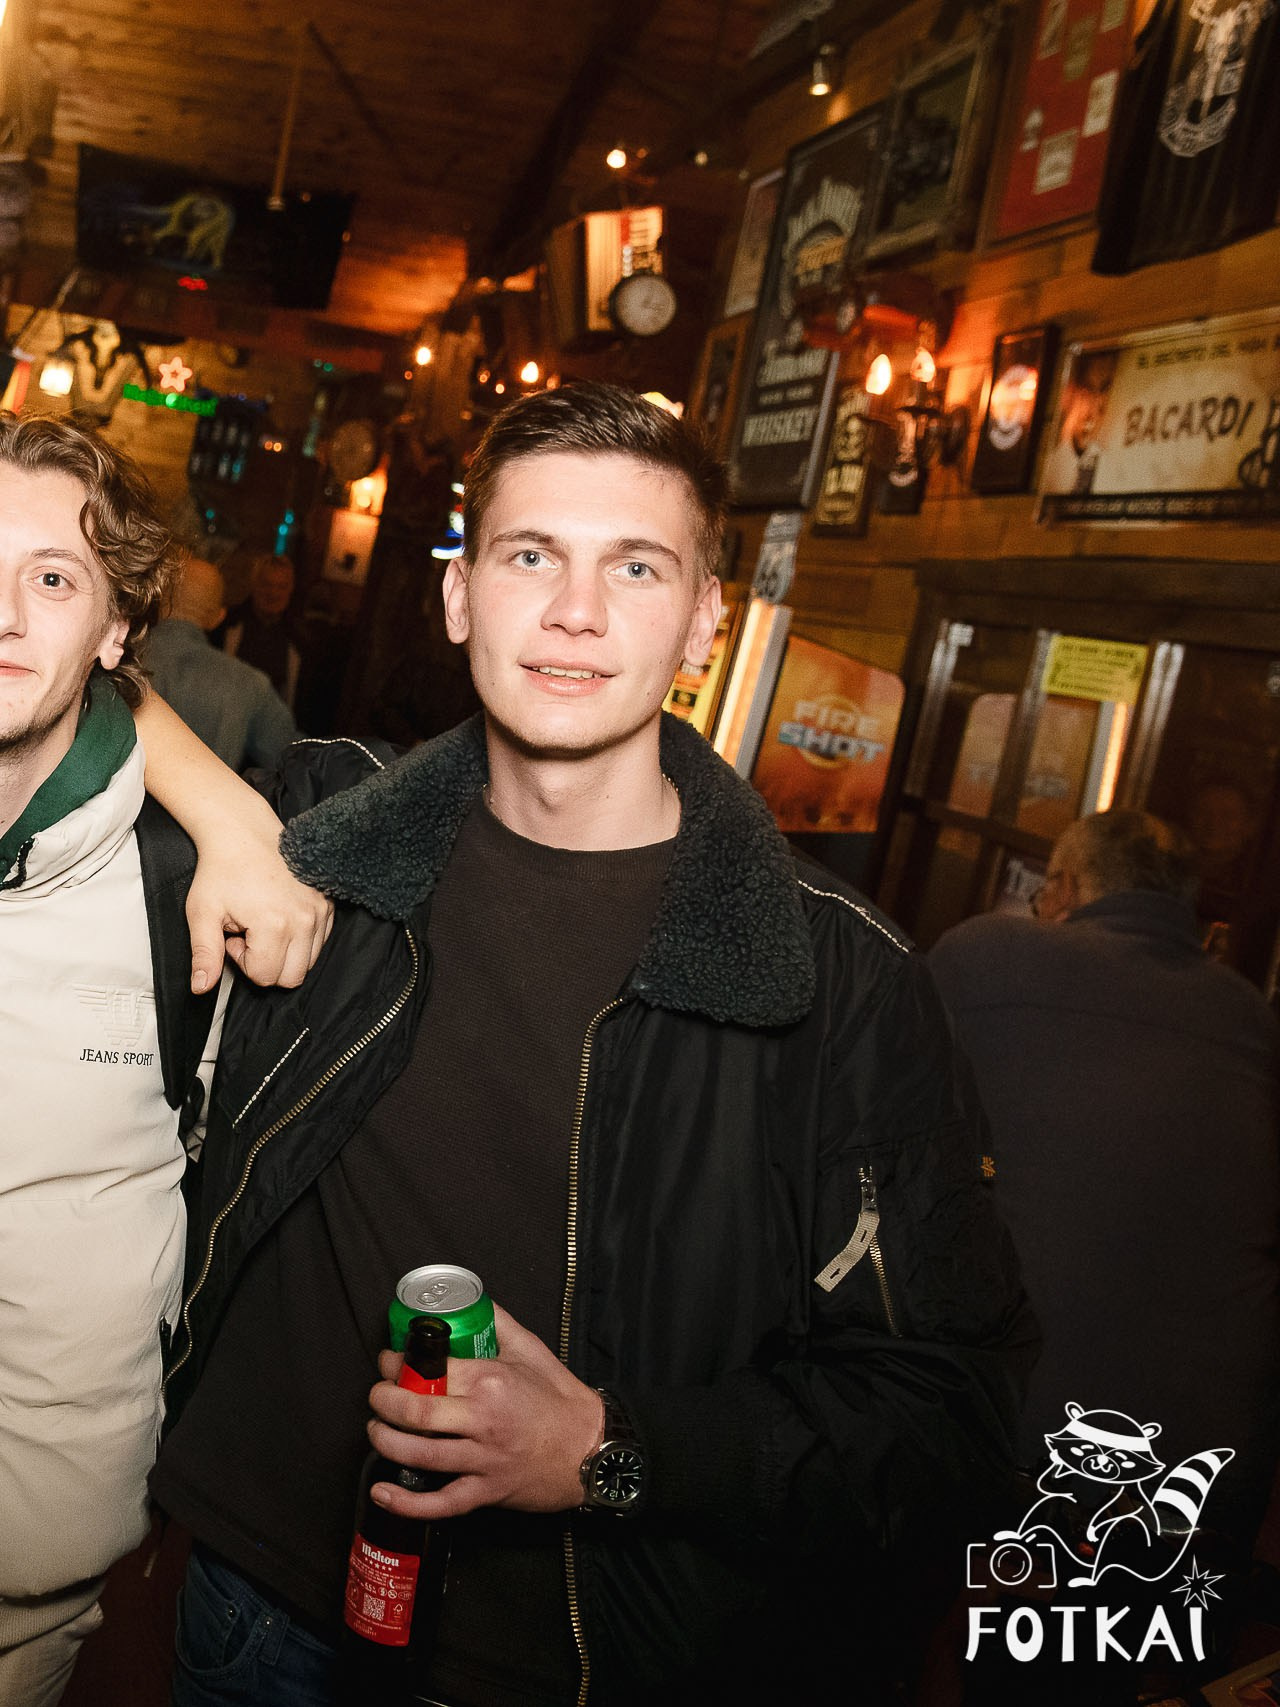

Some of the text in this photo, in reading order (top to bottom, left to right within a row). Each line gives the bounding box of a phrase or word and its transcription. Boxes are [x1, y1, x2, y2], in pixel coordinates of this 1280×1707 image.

[742, 404, 819, 448] WHISKEY
[1122, 393, 1256, 448] BACARDI
[793, 698, 881, 740] FIRE
[777, 720, 887, 764] SHOT
[79, 1048, 155, 1067] JEANS SPORT
[361, 1542, 400, 1567] Mahou
